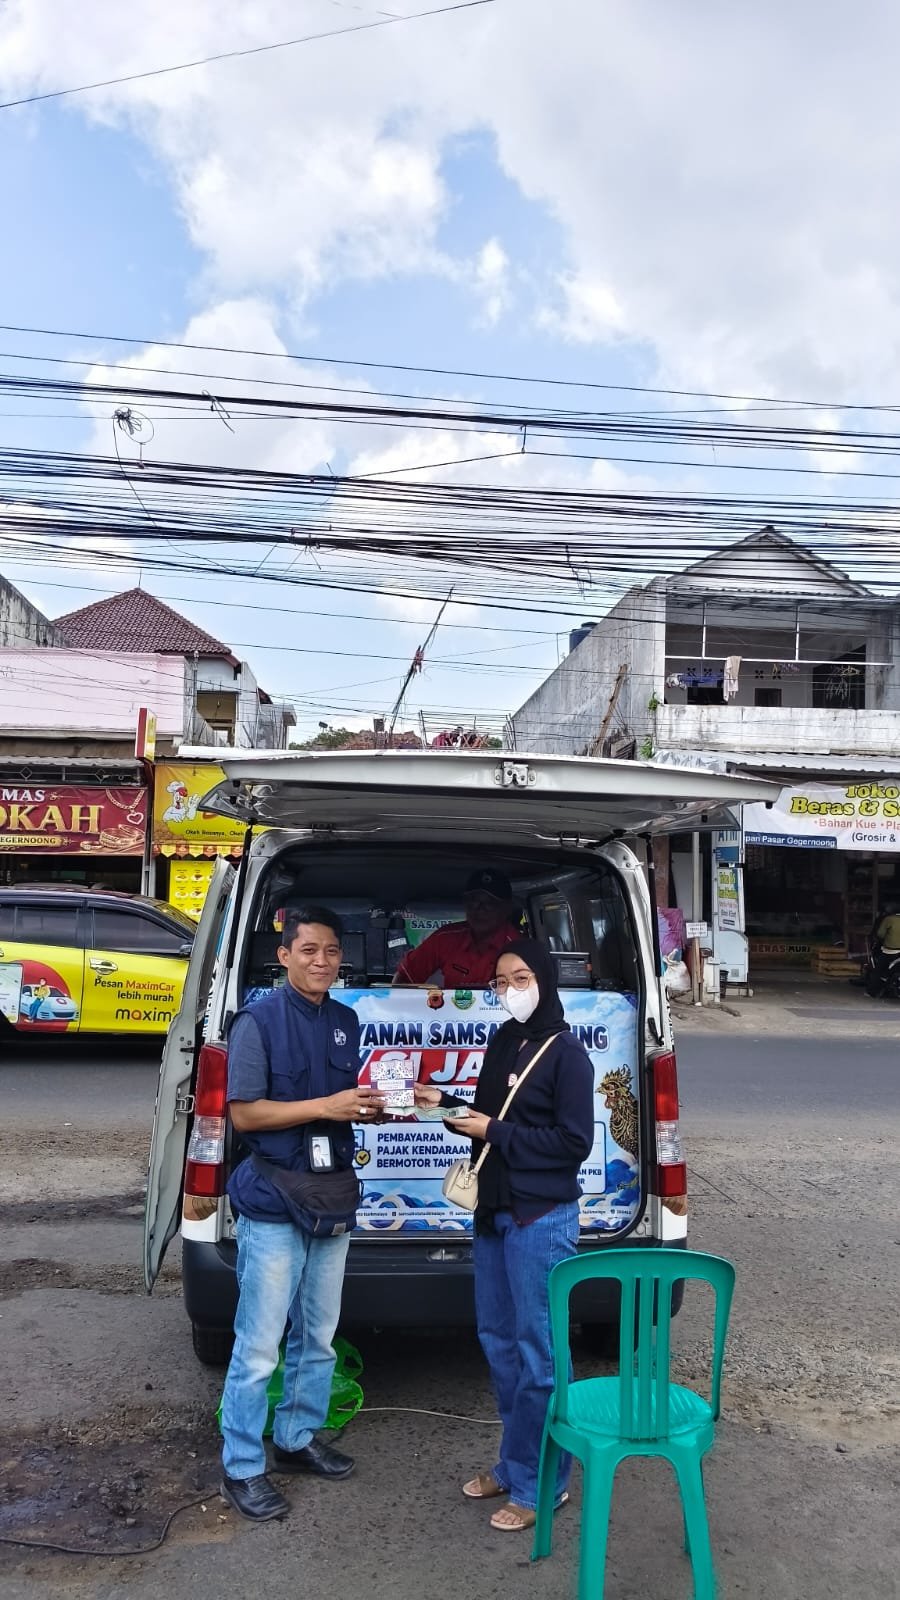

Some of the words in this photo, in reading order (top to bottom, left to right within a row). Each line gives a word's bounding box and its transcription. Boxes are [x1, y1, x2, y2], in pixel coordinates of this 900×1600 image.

[2, 789, 46, 802] MAS
[846, 783, 899, 799] Toko
[790, 797, 855, 815] Beras
[858, 799, 880, 816] &
[819, 818, 852, 828] Bahan
[855, 820, 877, 829] Kue
[762, 835, 785, 844] Pasar
[787, 836, 835, 848] Gegernoong
[852, 832, 886, 843] (Grosir
[889, 834, 896, 842] &
[94, 978, 123, 988] Pesan
[126, 980, 175, 991] MaximCar
[118, 991, 141, 1000] lebih
[144, 993, 174, 1002] murah
[116, 1008, 172, 1022] maxim
[429, 1022, 503, 1046] SAMSA
[377, 1133, 444, 1142] PEMBAYARAN
[376, 1146, 409, 1155] PAJAK
[411, 1146, 472, 1155] KENDARAAN
[376, 1159, 431, 1168] BERMOTOR
